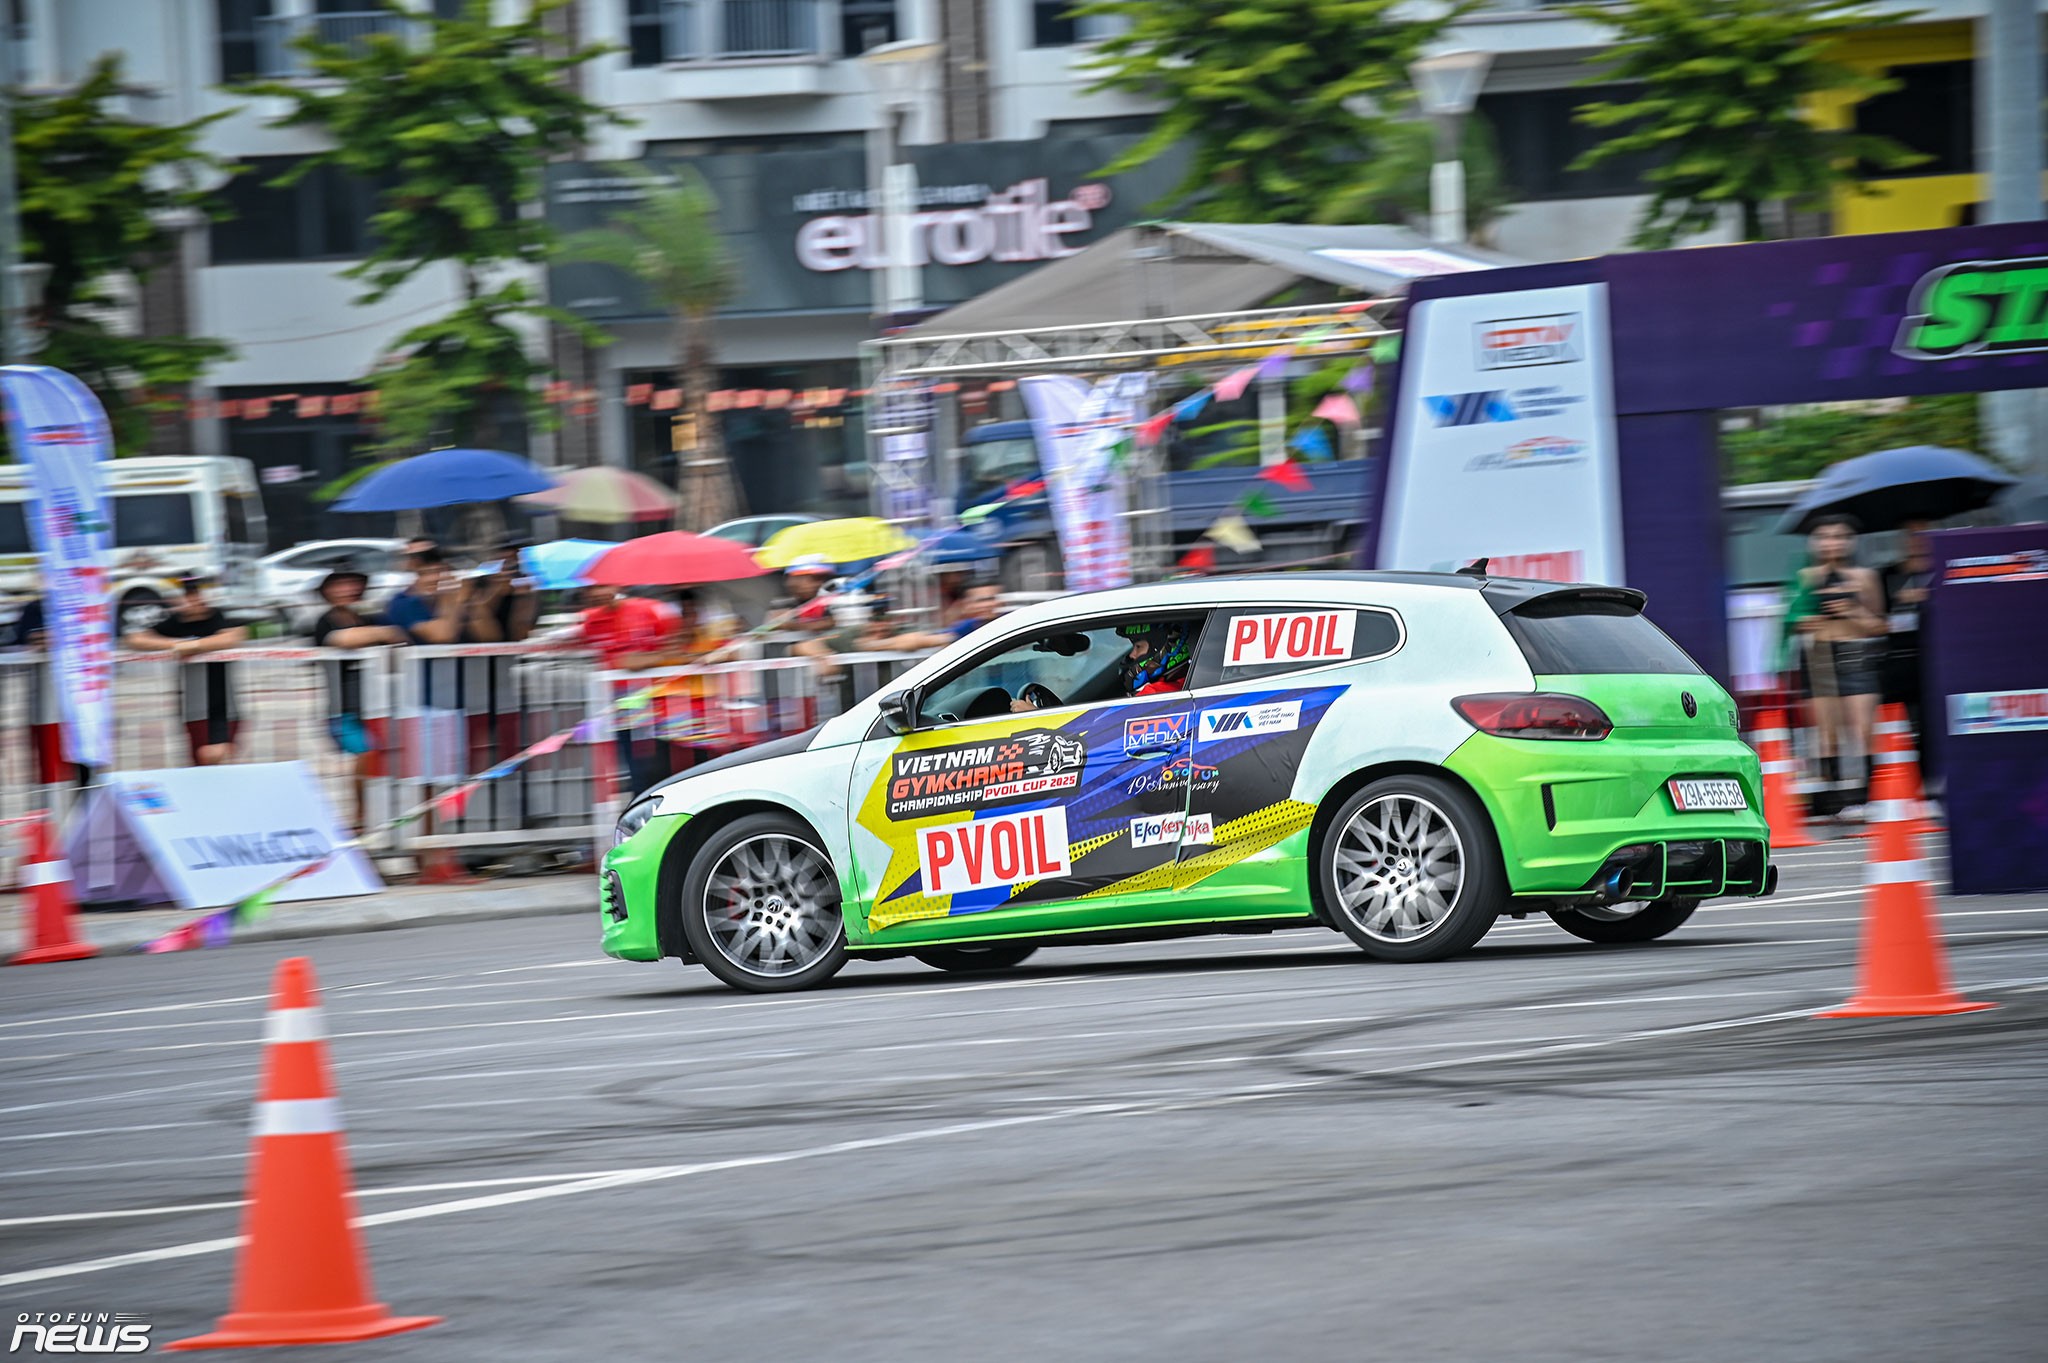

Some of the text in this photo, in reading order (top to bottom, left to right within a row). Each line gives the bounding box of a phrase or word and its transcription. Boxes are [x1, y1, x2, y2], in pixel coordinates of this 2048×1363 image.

[1232, 615, 1344, 661] PVOIL
[1129, 716, 1185, 735] OTV
[1129, 729, 1181, 746] MEDIA
[898, 746, 995, 776] VIETNAM
[892, 761, 1024, 799] GYMKHANA
[984, 775, 1076, 798] PVOIL CUP 2025
[891, 789, 983, 813] CHAMPIONSHIP
[926, 815, 1061, 891] PVOIL
